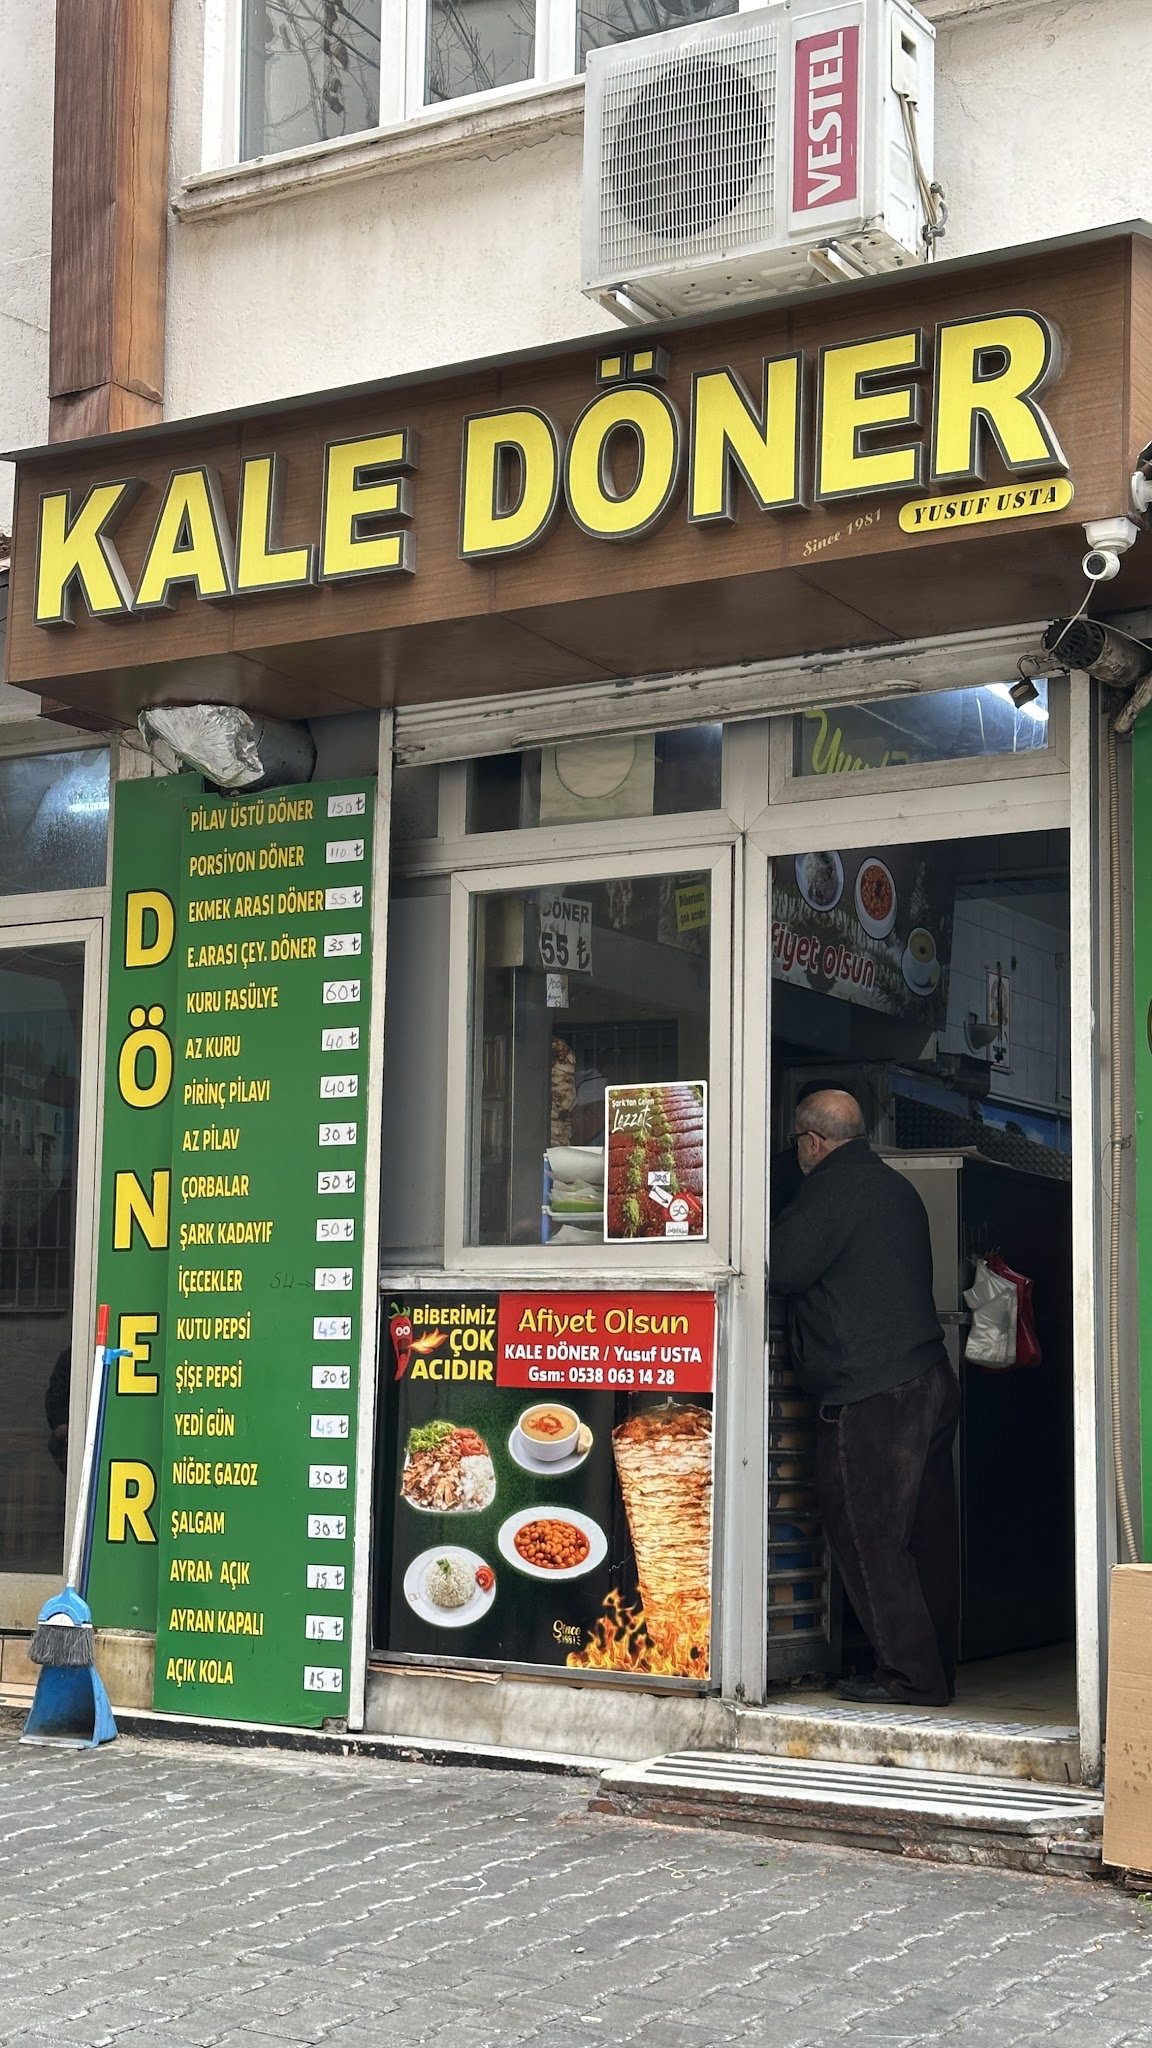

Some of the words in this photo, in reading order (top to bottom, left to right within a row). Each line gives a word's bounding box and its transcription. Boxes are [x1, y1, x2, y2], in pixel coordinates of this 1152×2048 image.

[808, 31, 844, 205] VESTEL
[34, 427, 415, 627] KALE
[459, 309, 1069, 561] DÖNER
[914, 497, 990, 524] YUSUF
[997, 487, 1057, 511] USTA
[802, 531, 841, 557] Since
[846, 507, 881, 534] 1981
[191, 804, 227, 832] PİLAV
[230, 799, 264, 828] ÜSTÜ
[268, 796, 313, 824] DÖNER
[189, 847, 256, 877] PORSİYON
[259, 842, 304, 870] DÖNER
[188, 898, 231, 922] EKMEK
[234, 894, 274, 918] ARASI
[277, 886, 324, 914] DÖNER
[187, 942, 238, 968] E.ARASI
[240, 940, 267, 969] ÇEY.
[271, 932, 317, 961] DÖNER
[541, 931, 569, 967] 55
[823, 944, 875, 989] olsun
[186, 990, 221, 1014] KURU
[224, 982, 279, 1011] FASÜLYE
[185, 1038, 203, 1059] AZ
[205, 1035, 241, 1058] KURU
[184, 1078, 226, 1109] PİRİNÇ
[229, 1075, 270, 1103] PİLAVI
[612, 1105, 650, 1134] Lezzet
[182, 1129, 200, 1151] AZ
[203, 1123, 240, 1151] PİLAV
[181, 1174, 249, 1204] ÇORBALAR
[106, 888, 176, 1544] DÖNER
[180, 1223, 214, 1250] ŞARK
[217, 1221, 273, 1244] KADAYIF
[178, 1265, 243, 1298] İÇECEKLER
[177, 1317, 211, 1340] KUTU
[214, 1311, 251, 1340] PEPSİ
[412, 1303, 496, 1326] BİBERİMİZ
[517, 1308, 597, 1338] Afiyet
[604, 1309, 689, 1335] Olsun
[450, 1328, 495, 1357] ÇOK
[504, 1344, 543, 1360] KALE
[546, 1343, 600, 1361] DÖNER
[614, 1347, 657, 1363] Yusuf
[660, 1349, 702, 1364] USTA
[175, 1360, 203, 1393] ŞİŞE
[205, 1360, 242, 1388] PEPSİ
[411, 1359, 494, 1381] ACIDIR
[528, 1366, 565, 1382] Gsm:
[568, 1367, 604, 1384] 0538
[607, 1368, 635, 1384] 063
[637, 1369, 653, 1385] 14
[656, 1369, 675, 1385] 28
[174, 1408, 203, 1436] YEDİ
[206, 1408, 235, 1436] GÜN
[173, 1456, 211, 1485] NİĞDE
[214, 1462, 258, 1486] GAZOZ
[171, 1511, 225, 1538] ŞALGAM
[169, 1559, 212, 1583] AYRAN
[220, 1561, 250, 1590] AÇIK
[168, 1608, 215, 1633] AYRAN
[217, 1611, 264, 1636] KAPALI
[166, 1658, 197, 1687] AÇIK
[199, 1658, 234, 1684] KOLA
